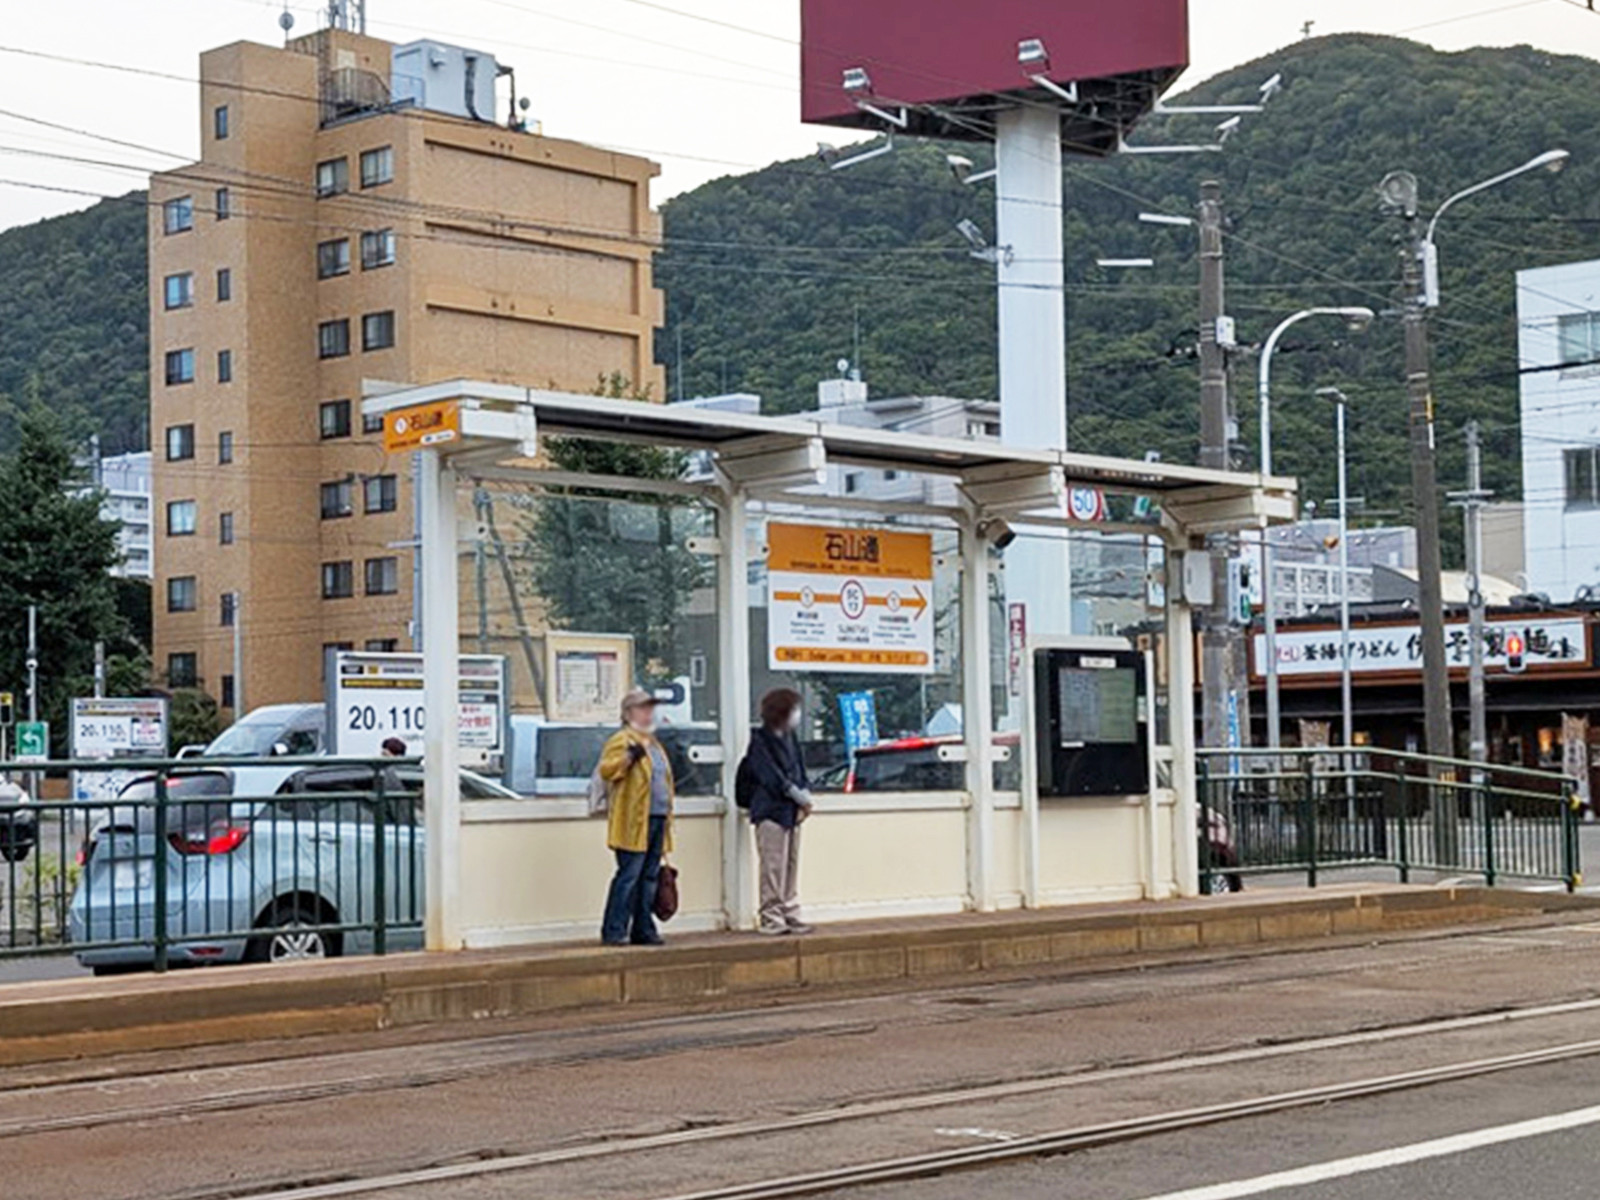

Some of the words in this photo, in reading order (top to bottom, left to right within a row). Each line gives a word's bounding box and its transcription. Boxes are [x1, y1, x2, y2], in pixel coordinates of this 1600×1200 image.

[1073, 486, 1093, 512] 50
[825, 532, 880, 563] 石山通
